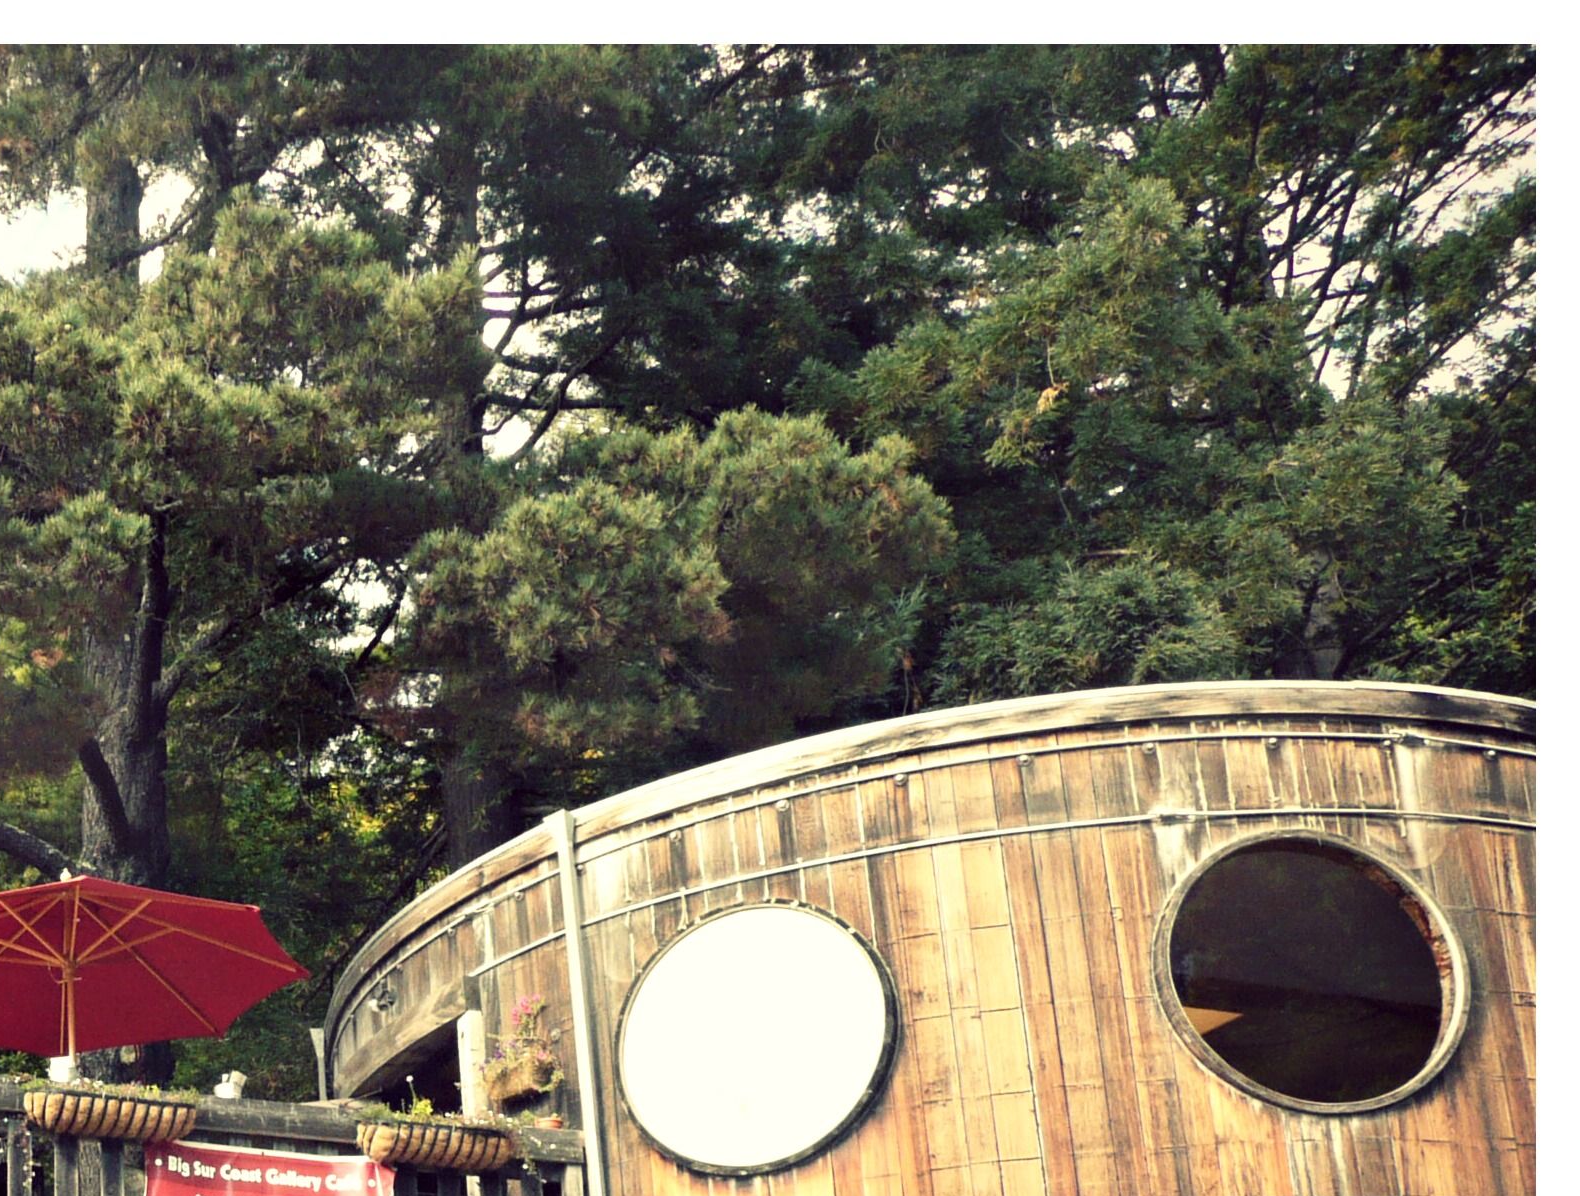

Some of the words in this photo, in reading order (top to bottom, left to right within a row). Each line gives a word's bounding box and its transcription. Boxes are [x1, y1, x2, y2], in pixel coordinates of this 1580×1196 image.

[168, 1155, 190, 1177] Big
[193, 1160, 216, 1179] Sur
[219, 1163, 262, 1184] Coast
[265, 1167, 322, 1192] Gallery
